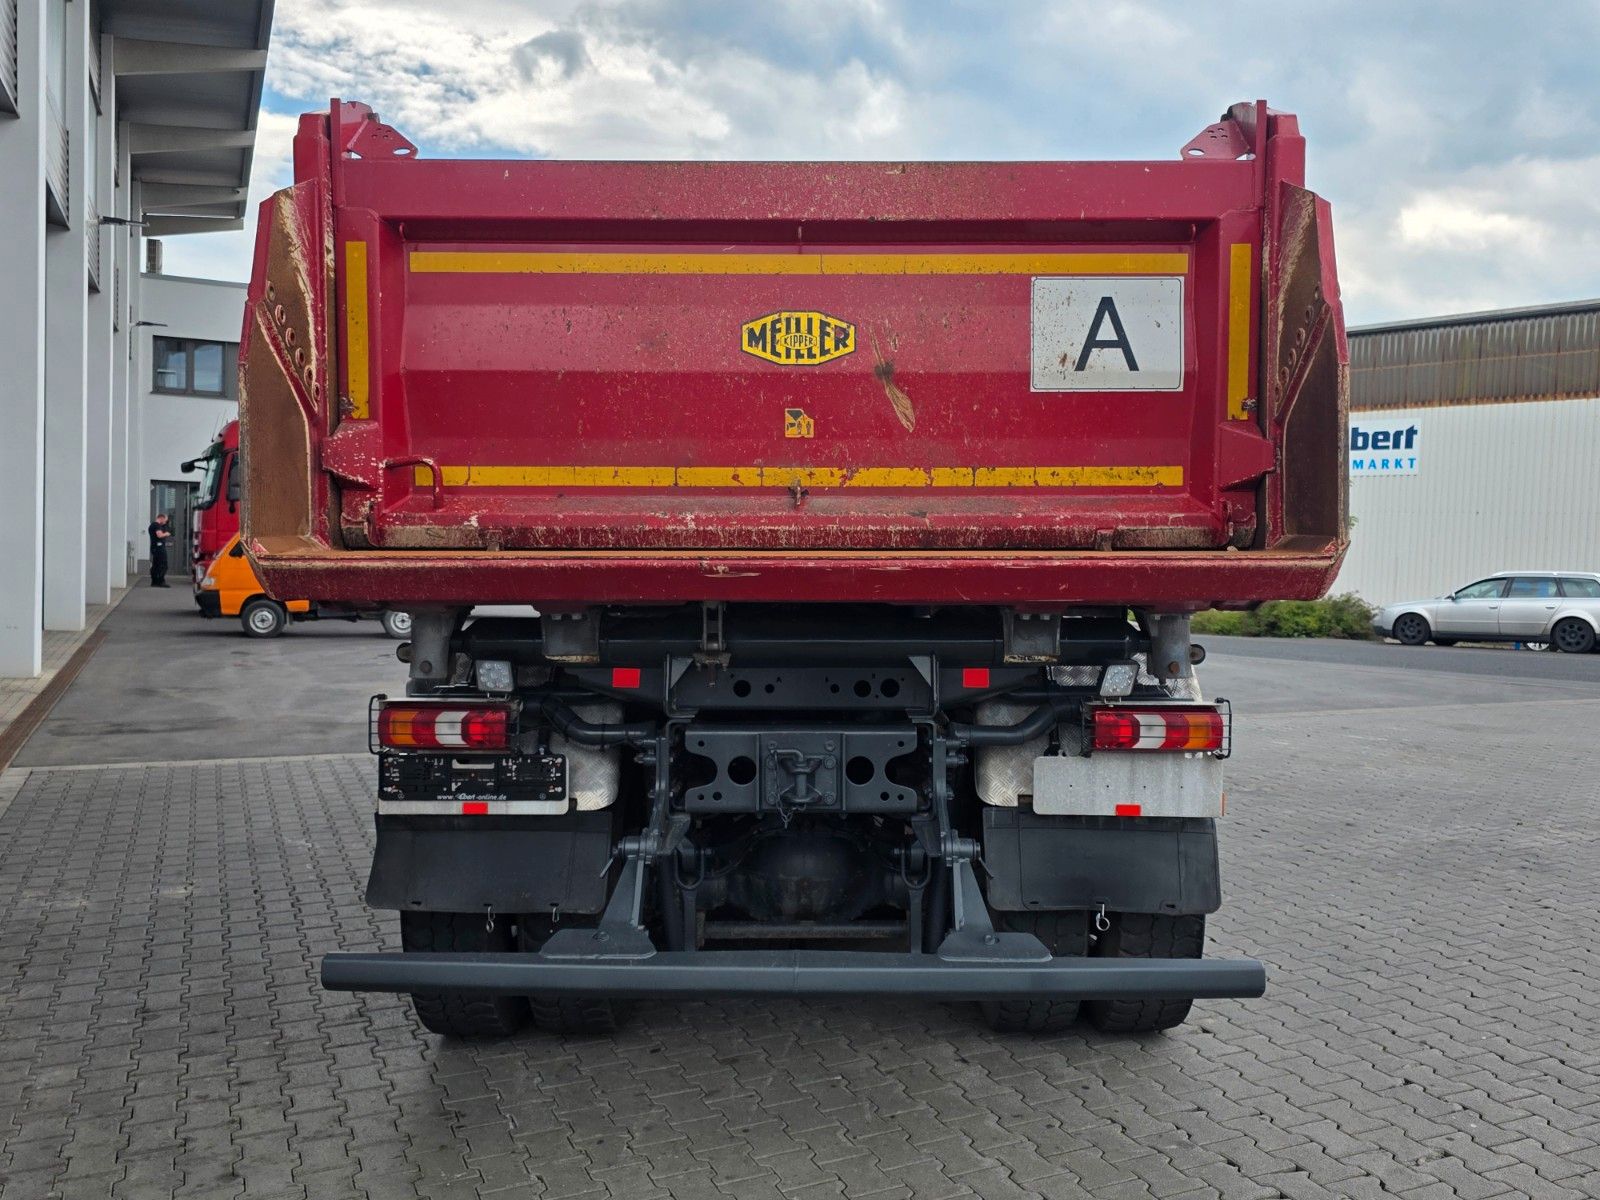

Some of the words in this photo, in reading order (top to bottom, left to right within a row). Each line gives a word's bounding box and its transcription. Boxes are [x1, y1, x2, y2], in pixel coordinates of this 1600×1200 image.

[746, 317, 851, 360] MEILLER
[783, 334, 814, 347] KIPPER
[1074, 296, 1140, 372] A
[1352, 457, 1417, 470] MARKT
